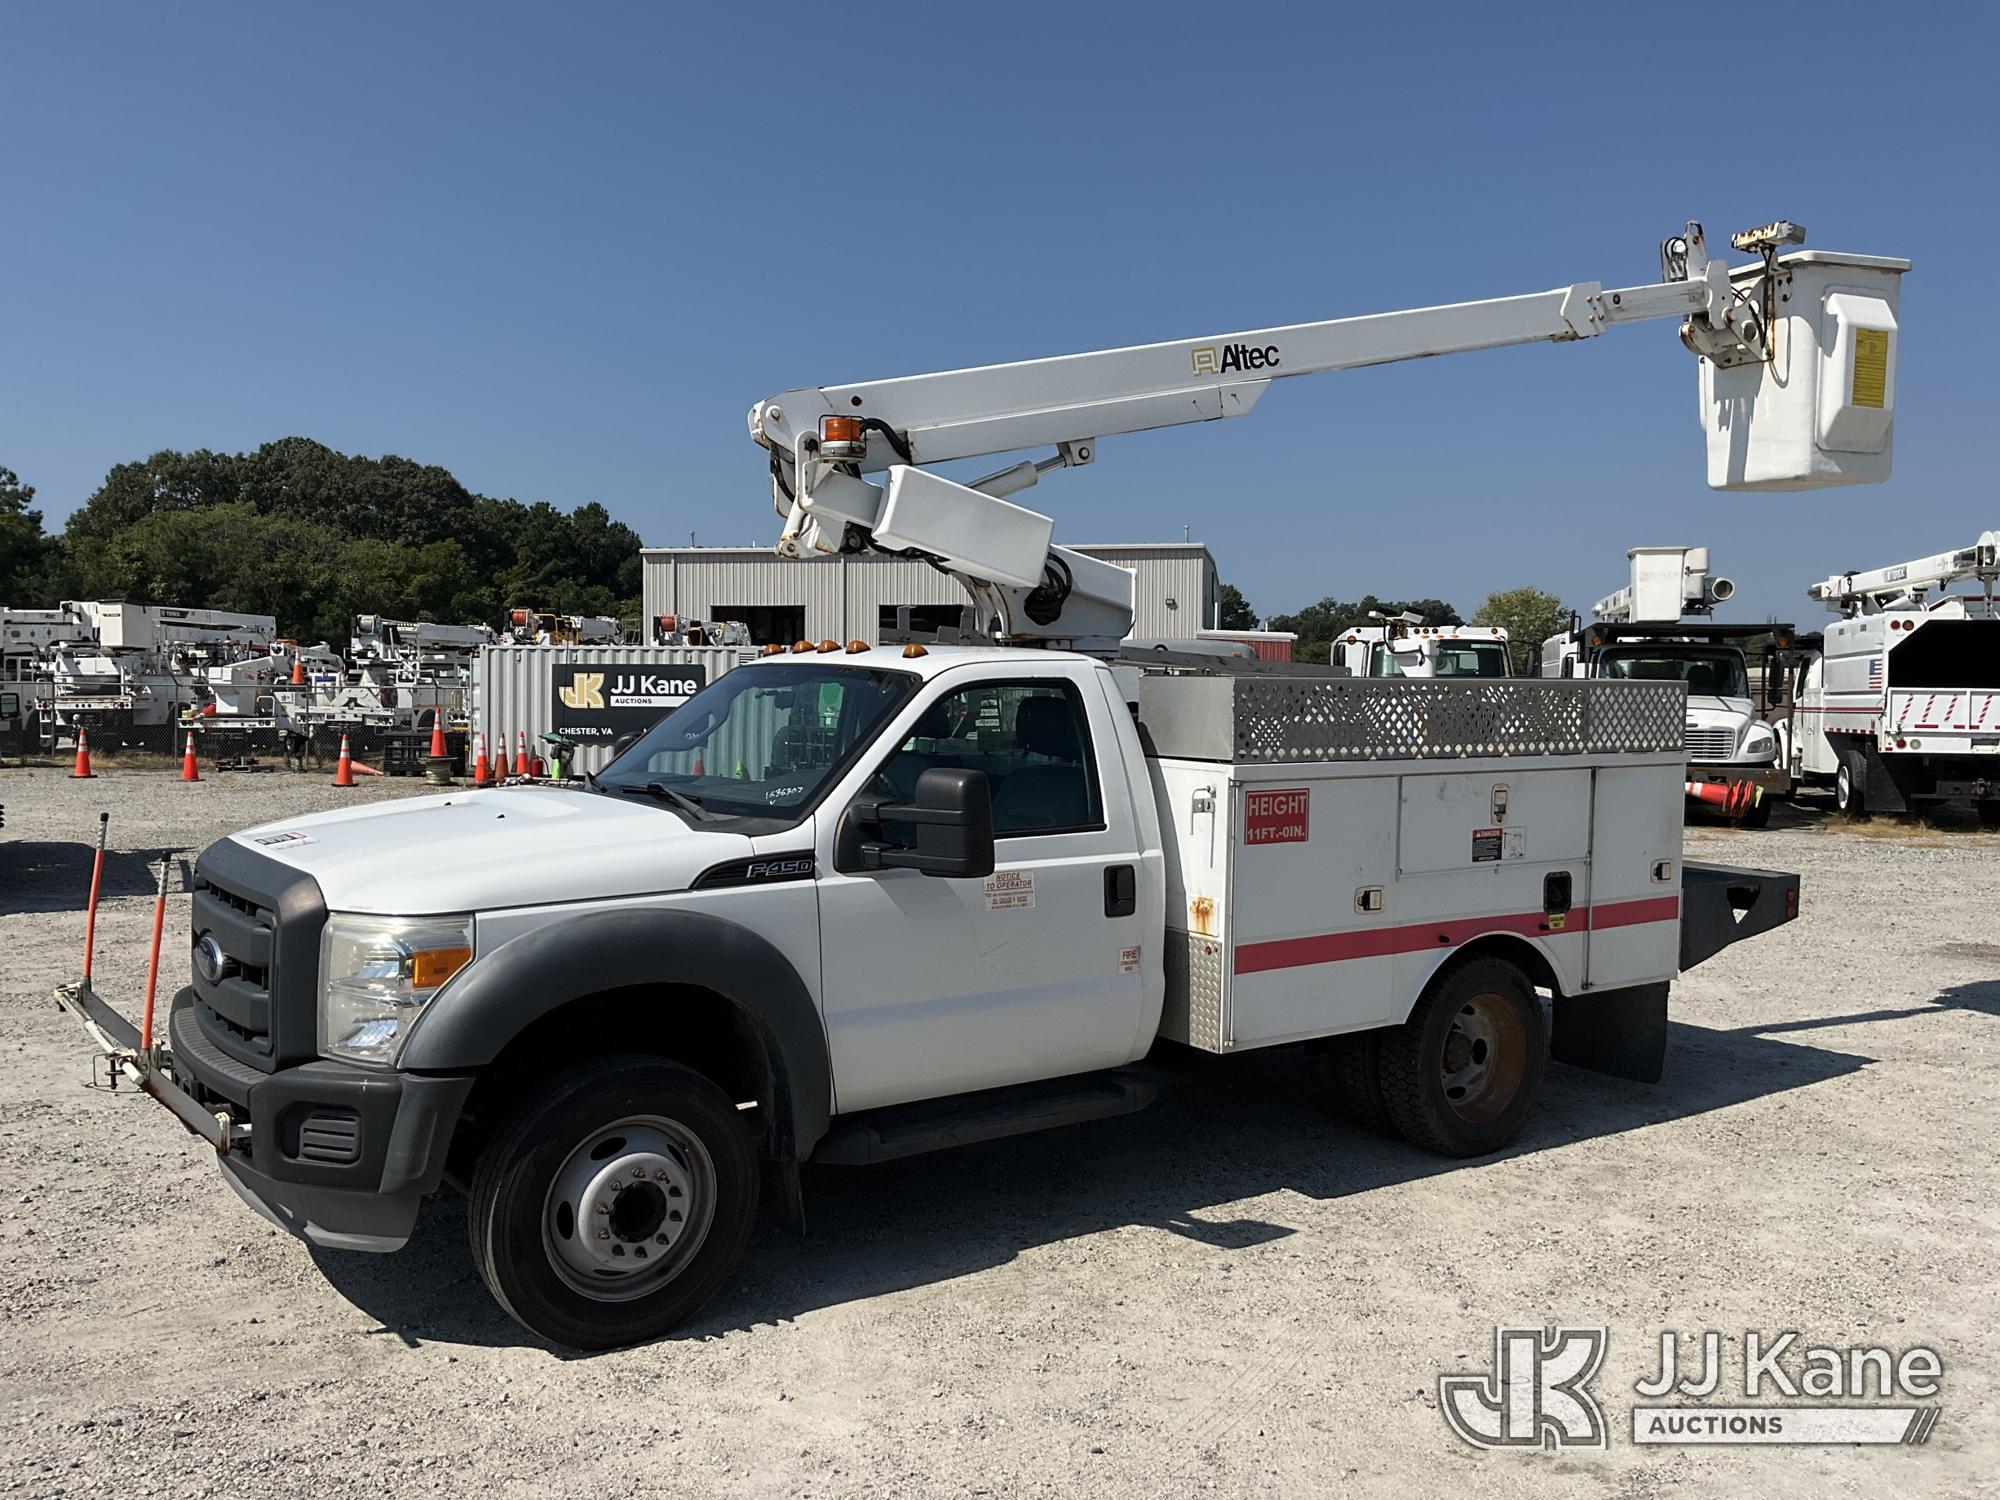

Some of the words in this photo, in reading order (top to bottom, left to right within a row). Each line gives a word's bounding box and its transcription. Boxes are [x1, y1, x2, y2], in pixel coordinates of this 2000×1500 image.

[1220, 344, 1280, 374] Altec
[610, 675, 635, 695] JJ
[641, 675, 697, 695] Kane
[559, 727, 600, 736] CHESTER,
[601, 727, 613, 735] VA
[1248, 795, 1306, 817] HEIGHT
[997, 880, 1032, 888] OPERATOR
[1122, 950, 1137, 959] FIRE
